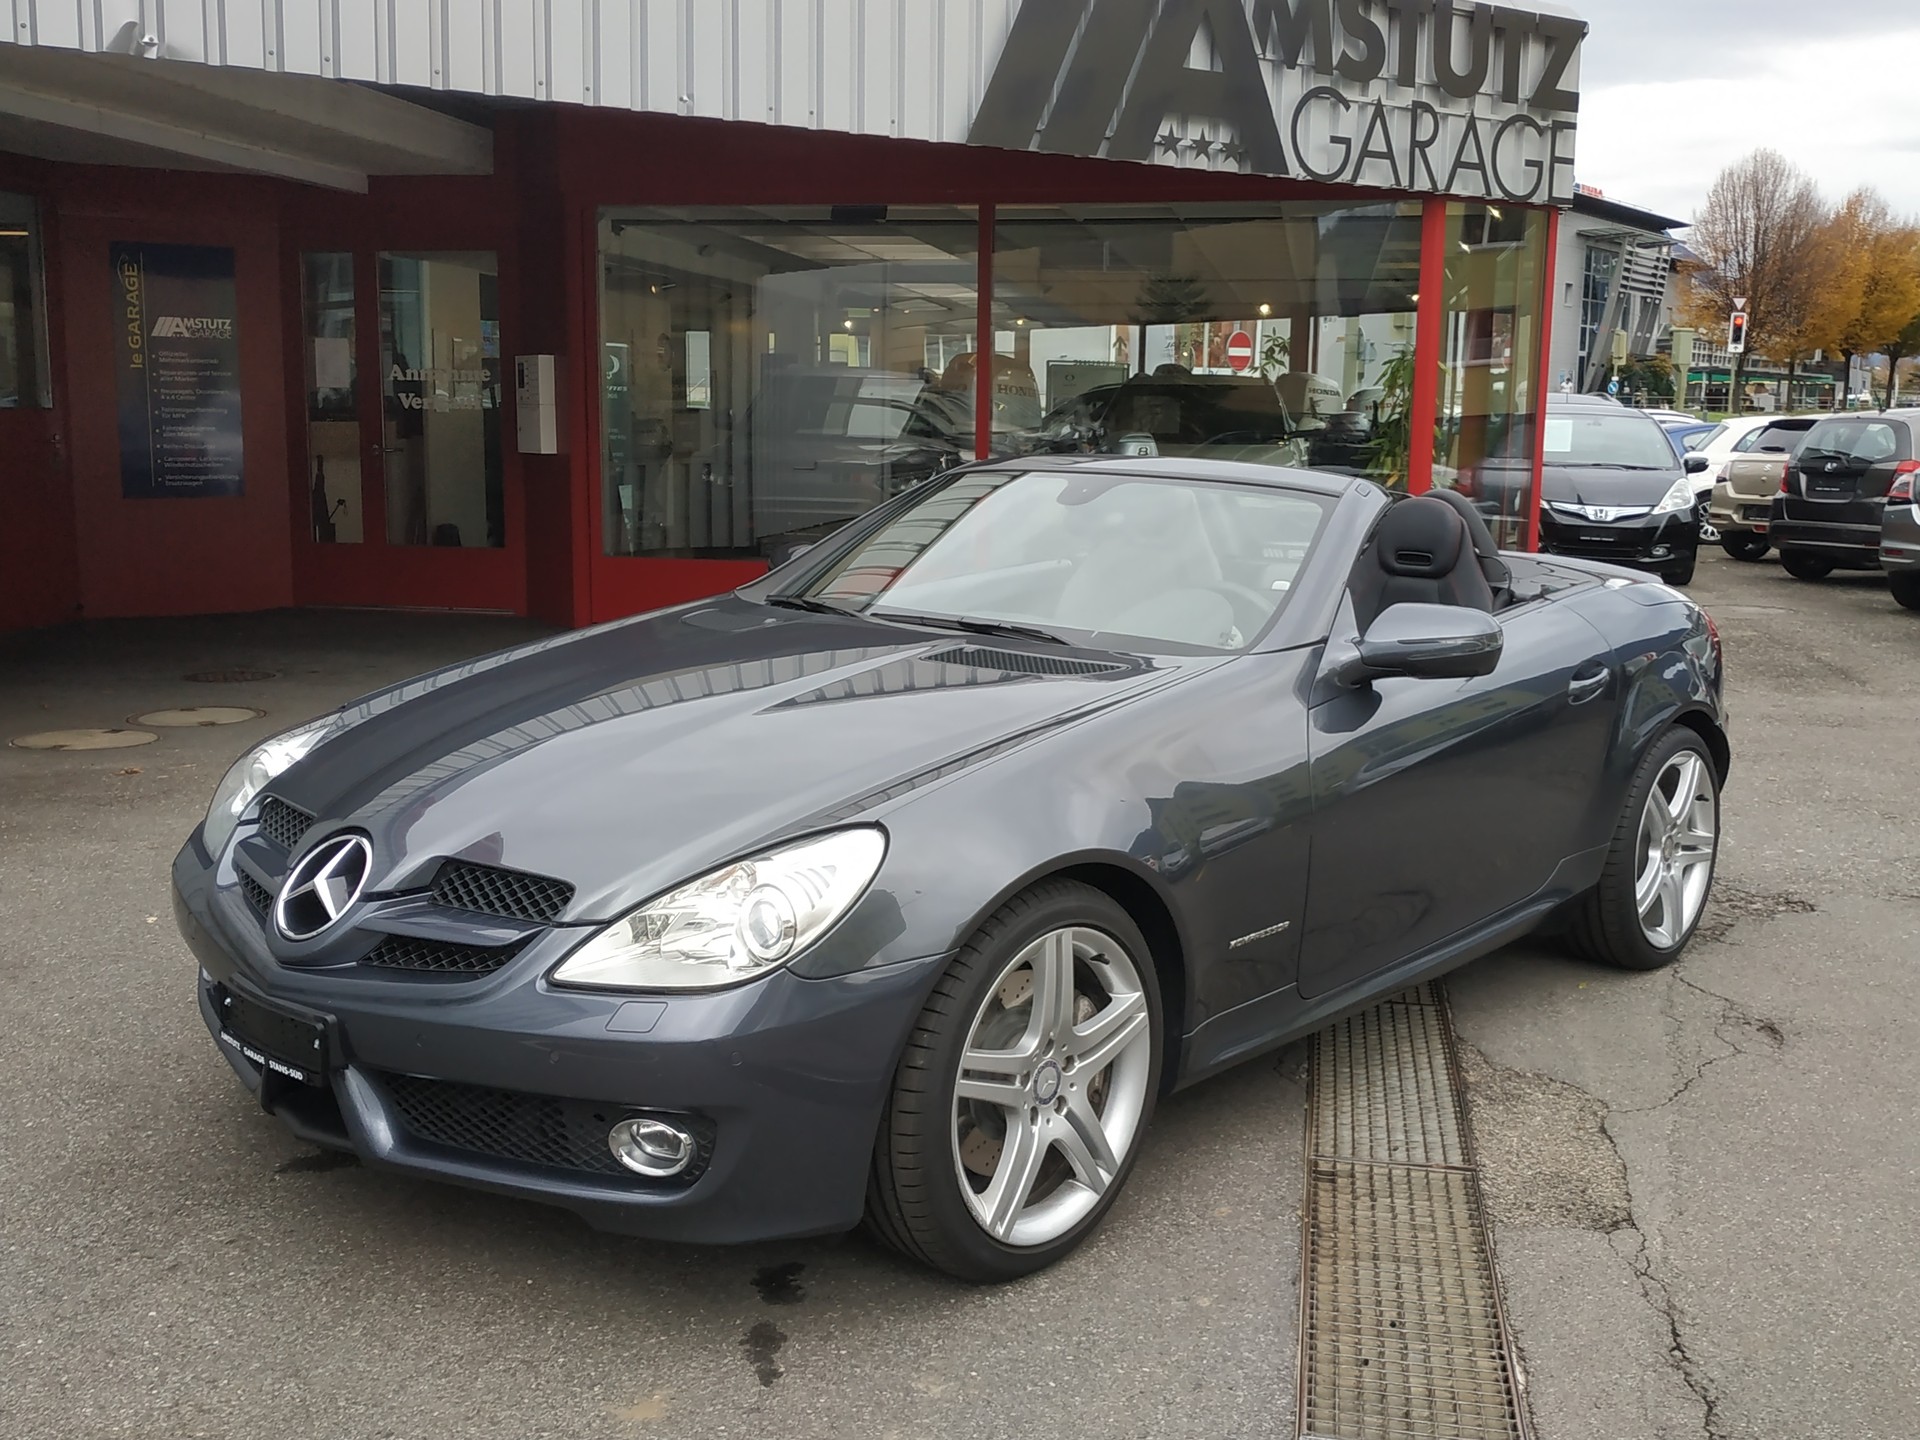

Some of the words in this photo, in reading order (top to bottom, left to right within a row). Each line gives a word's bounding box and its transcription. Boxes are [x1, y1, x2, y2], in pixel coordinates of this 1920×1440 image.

[1104, 0, 1590, 175] AMSTUTZ
[1290, 86, 1577, 204] GARAGE
[125, 263, 142, 350] GARAGE
[161, 316, 232, 338] AMSTUTZ
[188, 328, 232, 340] GARAGE
[129, 352, 144, 369] le
[1308, 387, 1340, 397] HONDA
[243, 1047, 265, 1064] GARAGE
